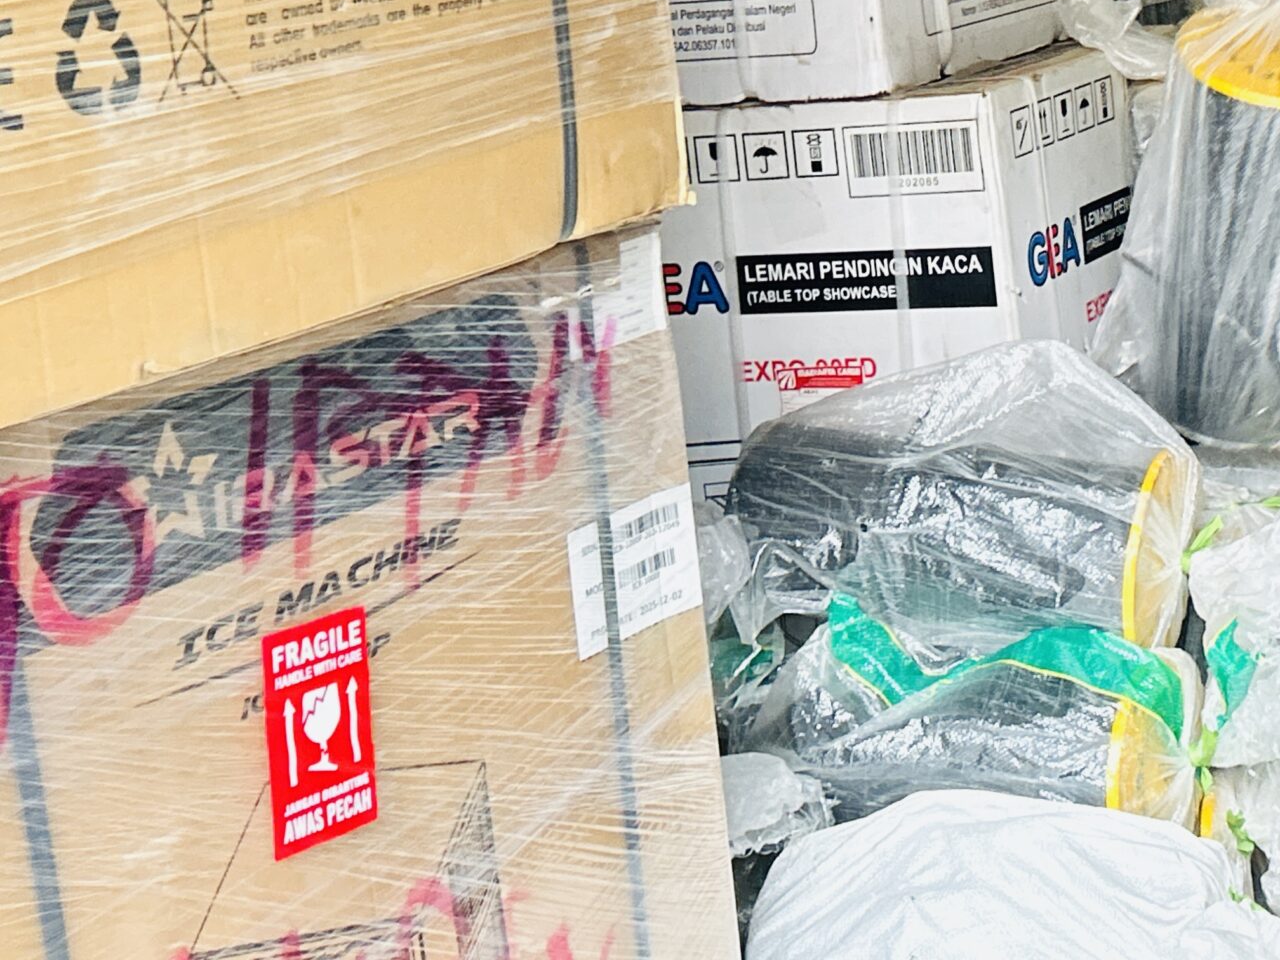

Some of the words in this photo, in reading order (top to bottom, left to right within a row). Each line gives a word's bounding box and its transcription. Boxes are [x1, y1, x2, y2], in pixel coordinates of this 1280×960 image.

[246, 11, 268, 26] are
[387, 9, 406, 21] are
[413, 4, 431, 16] the
[677, 25, 693, 36] dan
[696, 23, 725, 35] Pelaku
[745, 6, 767, 16] alam
[769, 3, 796, 18] Negeri
[1028, 217, 1080, 287] GEA
[662, 260, 729, 316] EA
[744, 261, 815, 283] LEMARI
[927, 254, 984, 277] KACA
[746, 287, 793, 307] (TABLE
[794, 287, 821, 303] TOP
[171, 601, 264, 671] ICE
[275, 518, 461, 625] MACHINE
[272, 619, 362, 674] FRAGILE
[274, 666, 313, 691] HANDLE
[313, 657, 337, 676] WITH
[337, 648, 363, 668] CARE
[283, 807, 325, 845] AWAS
[326, 787, 373, 827] PECAH
